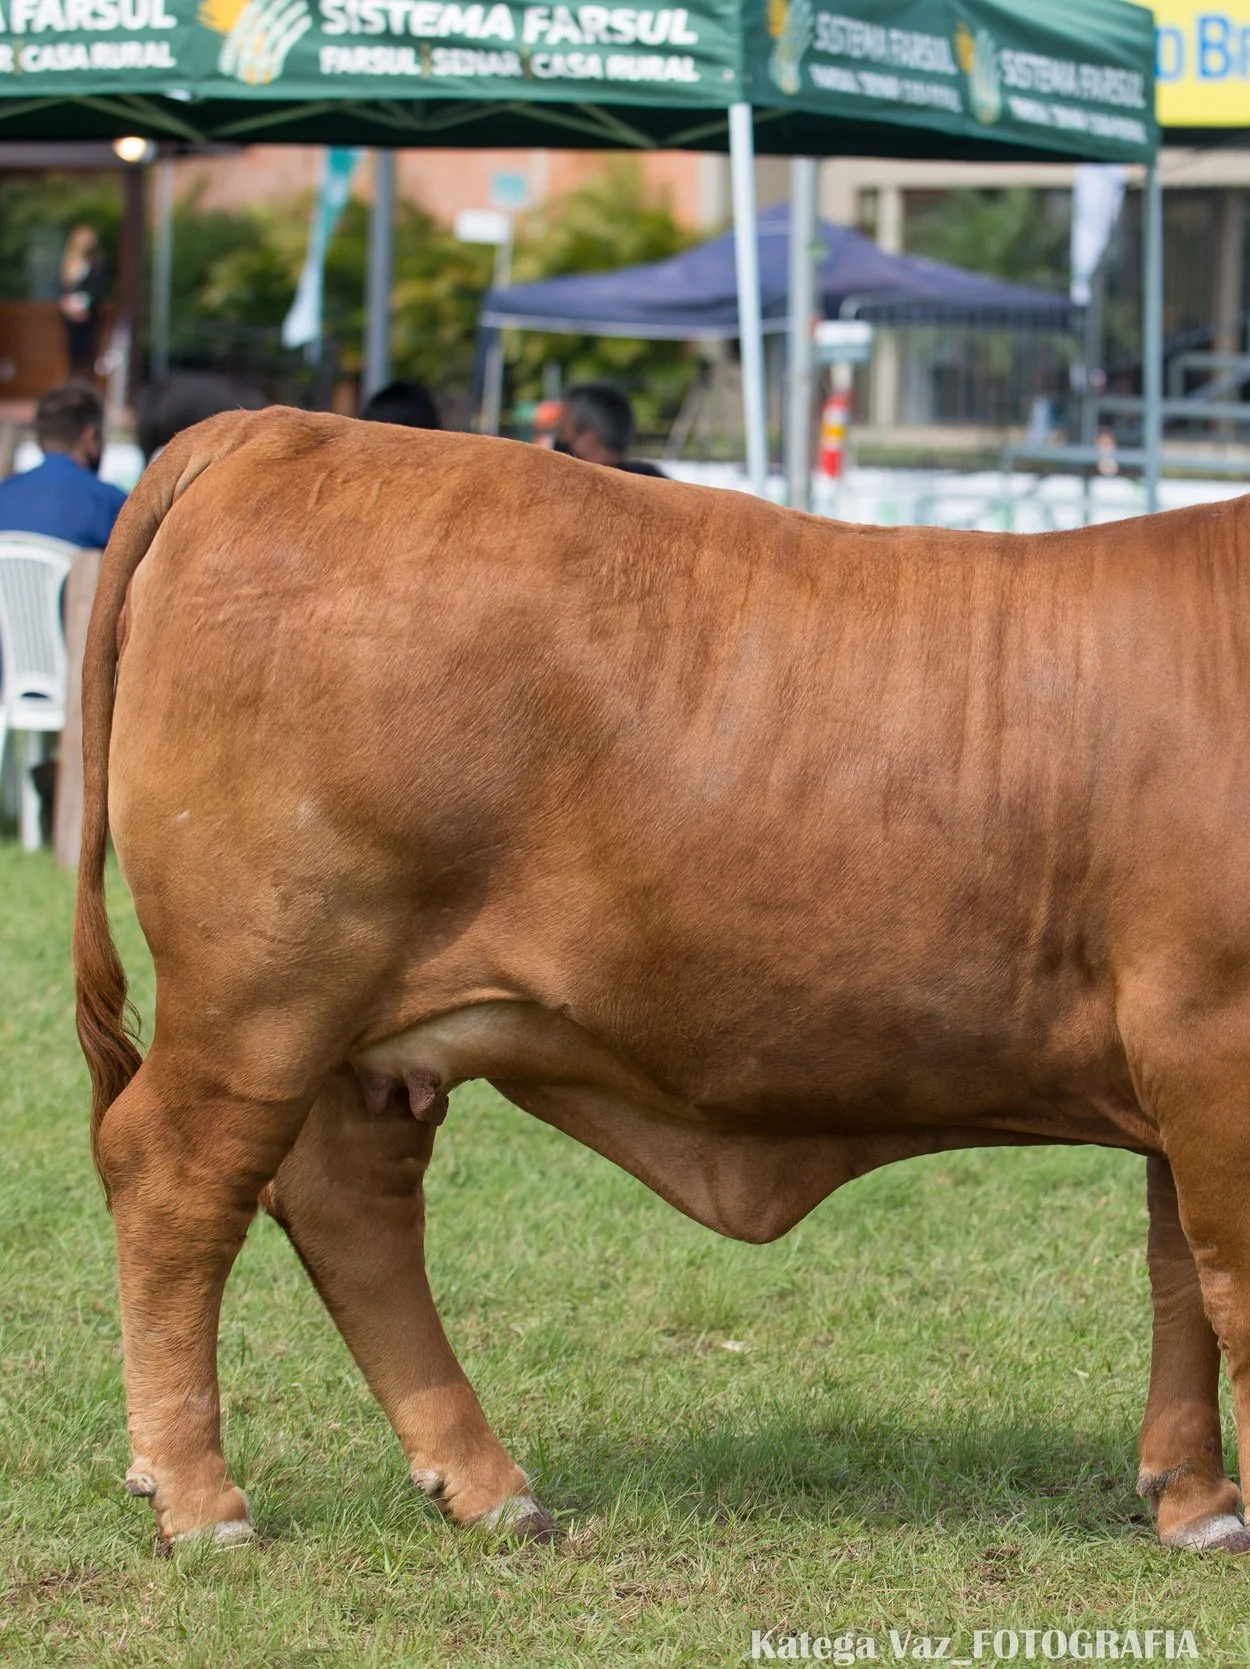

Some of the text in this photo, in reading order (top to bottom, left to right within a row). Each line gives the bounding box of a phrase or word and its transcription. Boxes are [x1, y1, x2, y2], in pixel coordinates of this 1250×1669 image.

[10, 0, 178, 34] FARSUL
[319, 0, 699, 46] SISTEMA FARSUL
